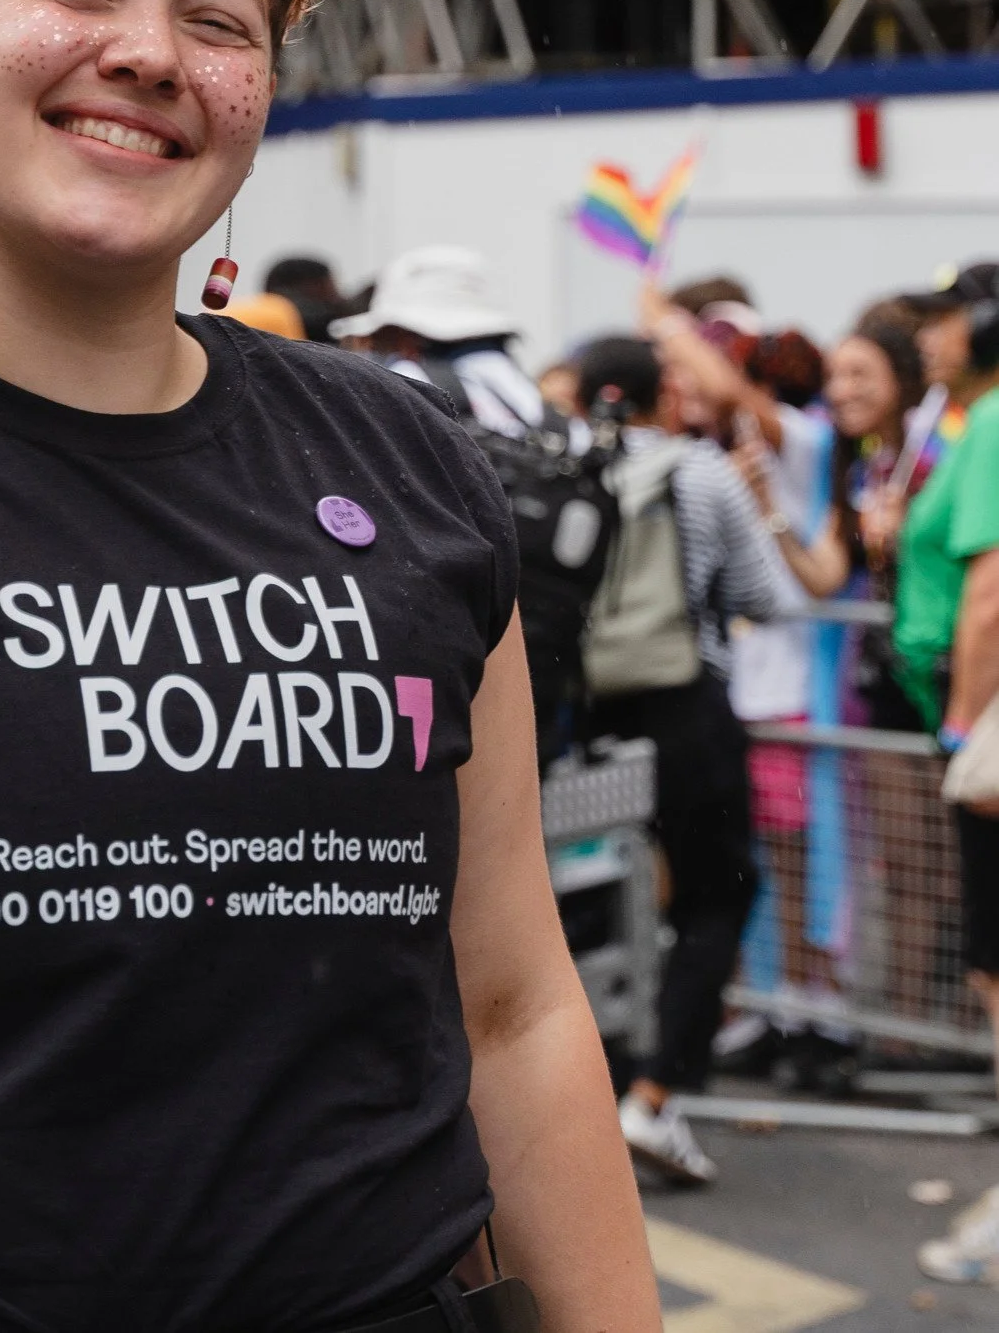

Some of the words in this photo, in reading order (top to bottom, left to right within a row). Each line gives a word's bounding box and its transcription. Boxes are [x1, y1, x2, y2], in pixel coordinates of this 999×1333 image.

[334, 510, 355, 520] She
[341, 520, 361, 530] Her
[79, 672, 395, 773] BOARD
[106, 834, 179, 866] out.
[185, 829, 304, 871] Spread
[312, 829, 361, 862] the
[367, 832, 428, 864] word.
[38, 886, 121, 924] 0119
[129, 884, 194, 919] 100
[225, 882, 440, 925] switchboard.lgbt
